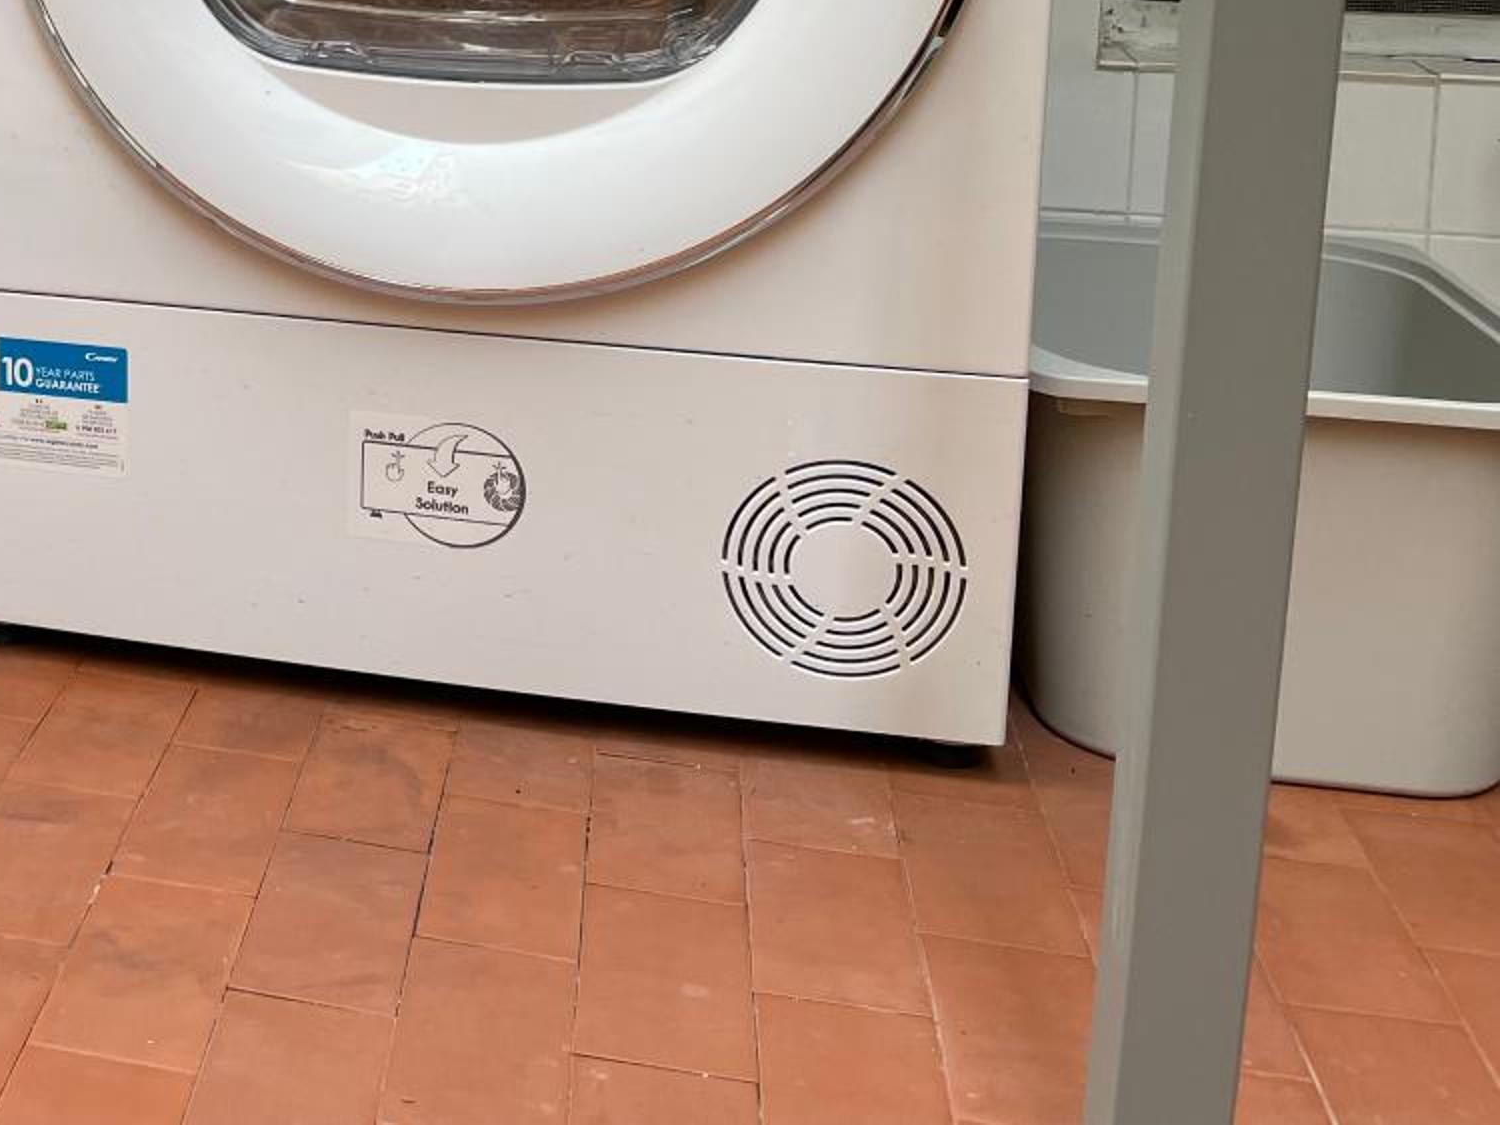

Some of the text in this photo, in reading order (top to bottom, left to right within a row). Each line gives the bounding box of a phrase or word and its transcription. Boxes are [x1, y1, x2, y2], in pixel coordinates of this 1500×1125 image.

[1, 356, 34, 388] 10
[36, 365, 96, 382] YEAR PARTS
[35, 378, 101, 394] GUARANTEE
[364, 428, 405, 442] Push Pull
[427, 480, 459, 498] Easy
[415, 496, 469, 515] Solution
